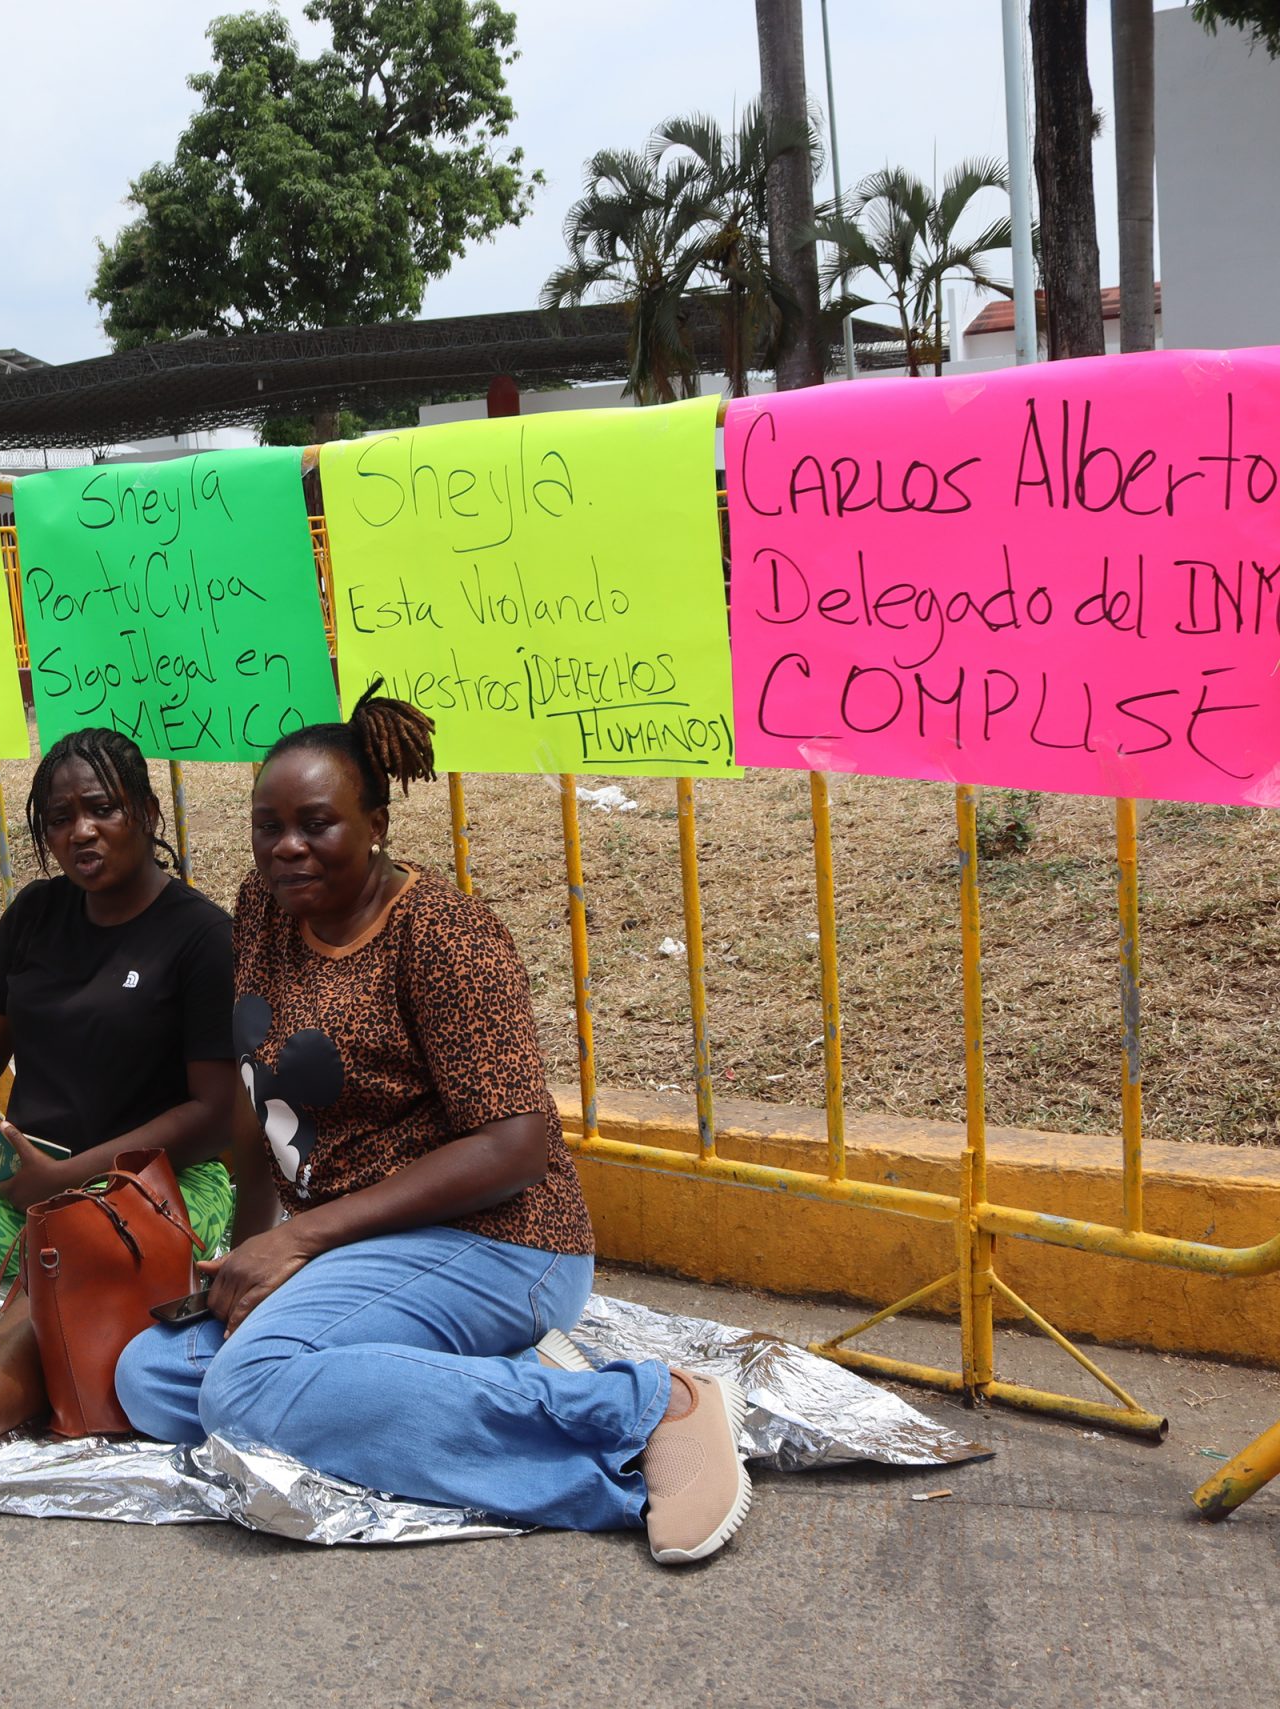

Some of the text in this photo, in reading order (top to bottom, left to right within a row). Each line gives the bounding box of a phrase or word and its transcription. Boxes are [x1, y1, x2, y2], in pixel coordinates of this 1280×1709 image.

[76, 455, 234, 546] Sheyla
[742, 392, 1278, 518] CARLOS Alberto
[347, 555, 630, 634] Esta Violando
[752, 544, 1053, 670] Delegado
[1074, 554, 1148, 639] del
[234, 648, 292, 694] en
